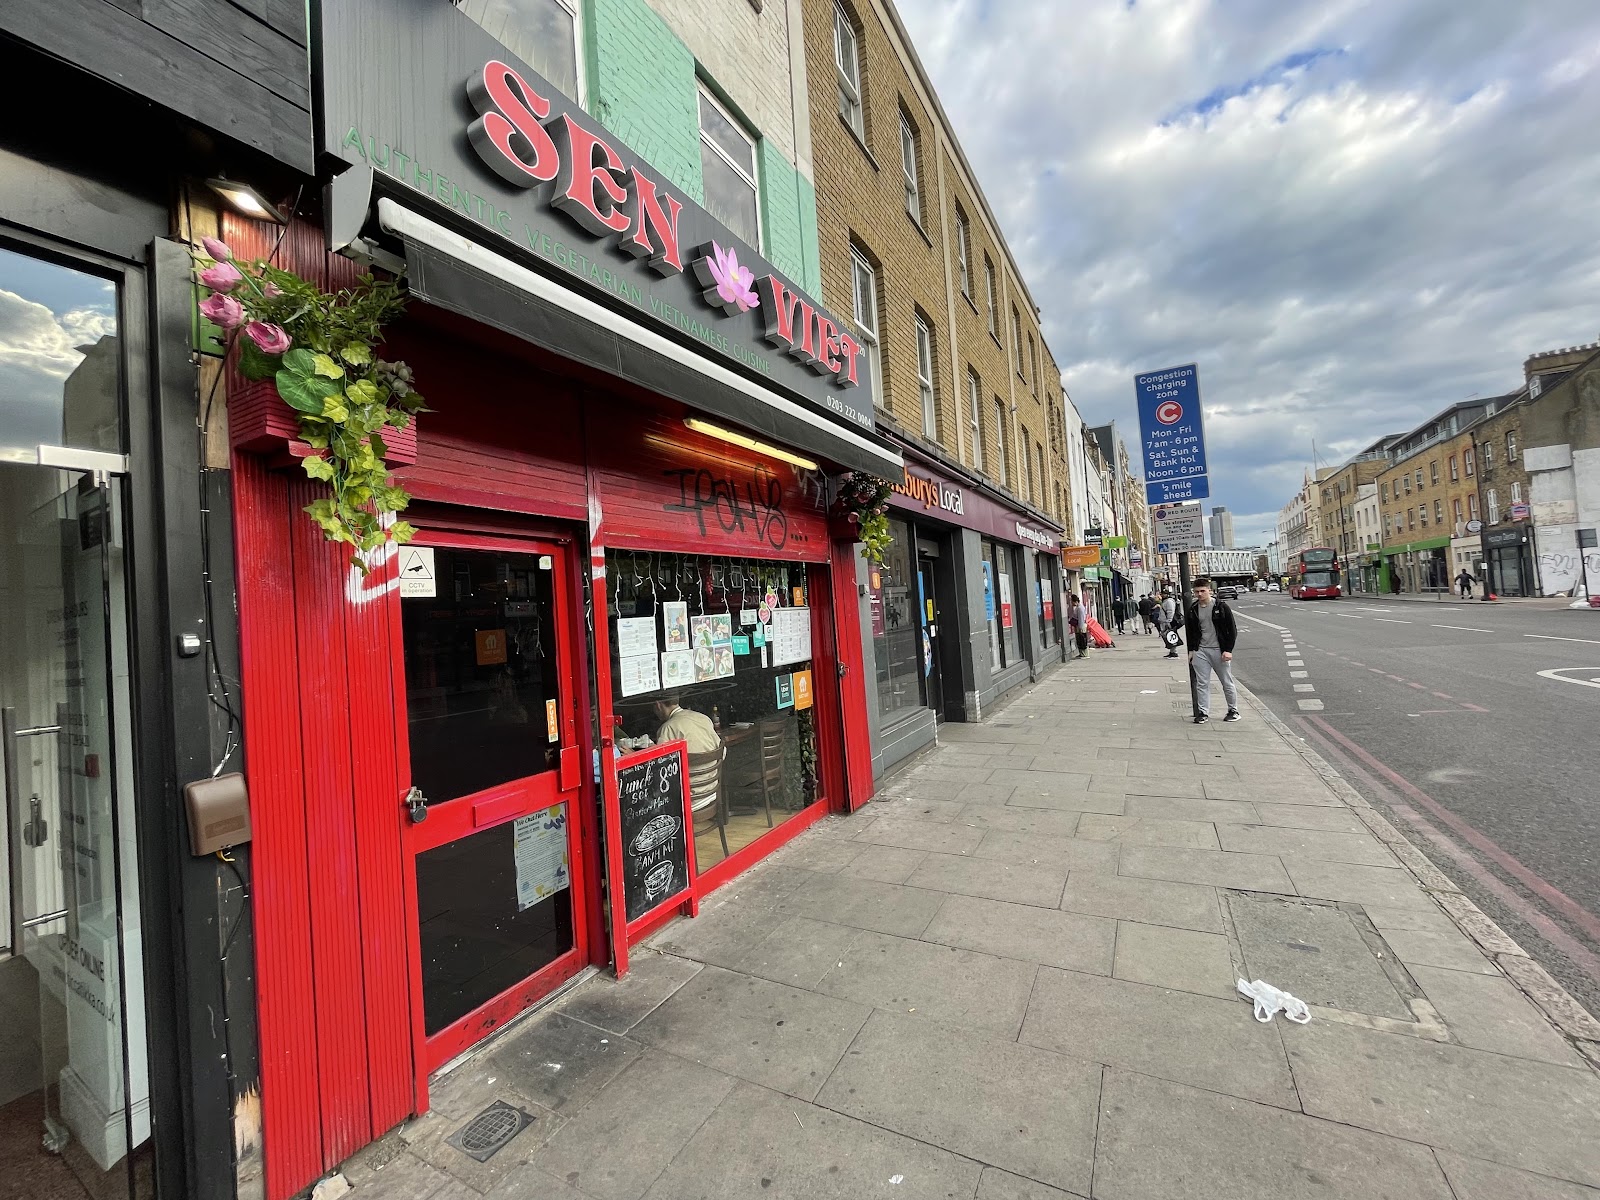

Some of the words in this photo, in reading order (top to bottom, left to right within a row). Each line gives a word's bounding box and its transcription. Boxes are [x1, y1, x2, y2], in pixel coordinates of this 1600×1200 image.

[484, 59, 684, 273] SEN
[342, 126, 512, 236] AUTHENTIC
[525, 224, 643, 305] VEGETARIAN
[649, 295, 728, 351] VIETNAMESE
[733, 343, 771, 375] CUISINE
[768, 273, 860, 388] VIET
[1140, 369, 1193, 384] Congestion
[1146, 380, 1187, 392] charging
[1156, 389, 1179, 399] zone
[827, 395, 843, 413] 0203
[845, 405, 857, 420] 222
[857, 411, 872, 428] 0004
[1151, 430, 1172, 439] Mon
[1179, 425, 1192, 434] Fri
[1170, 448, 1189, 457] Sun
[1192, 445, 1199, 453] &
[1154, 458, 1178, 468] Bank
[1180, 455, 1196, 464] hol
[1148, 469, 1174, 479] Noon
[1172, 481, 1192, 490] mile
[939, 481, 965, 515] Local
[1163, 489, 1192, 500] ahead
[1016, 521, 1027, 540] Open
[1067, 548, 1095, 557] Sainsbury's
[618, 765, 653, 798] Lunch
